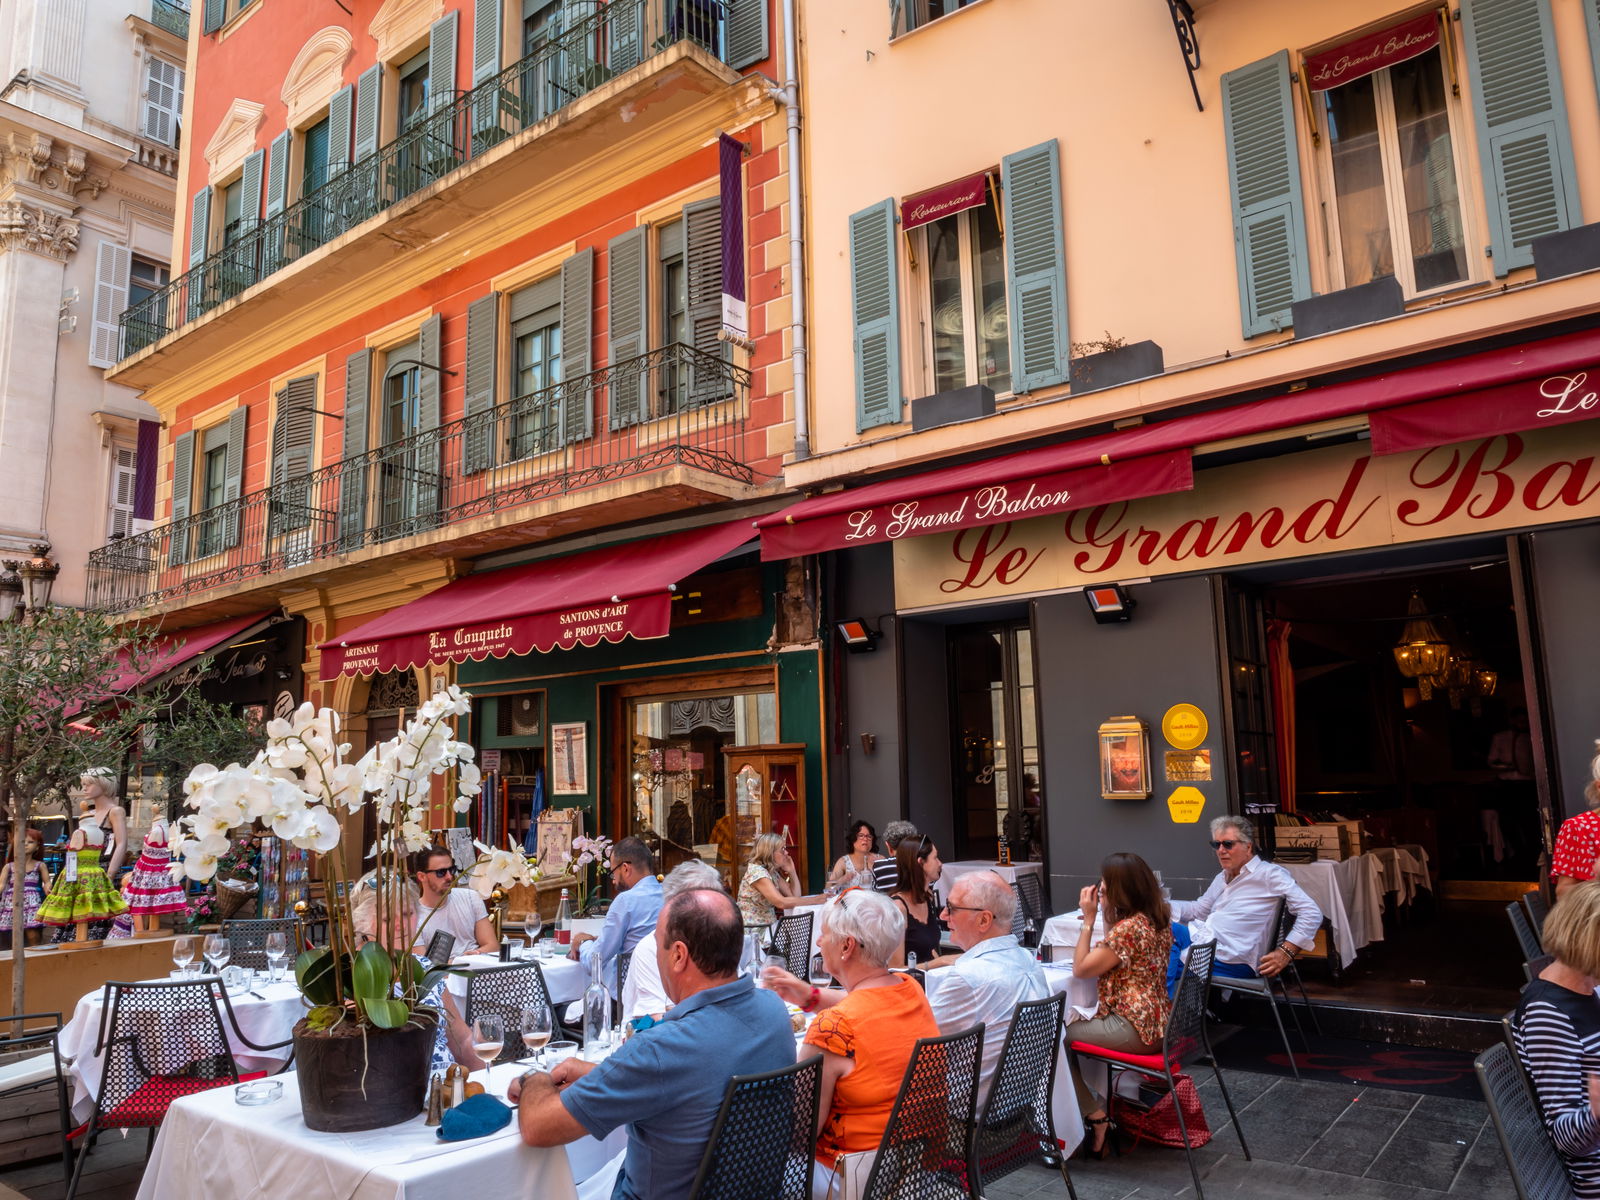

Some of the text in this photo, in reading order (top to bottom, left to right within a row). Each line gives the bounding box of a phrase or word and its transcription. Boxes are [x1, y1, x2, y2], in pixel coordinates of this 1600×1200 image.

[1312, 30, 1435, 81] Le Grand Balcon
[911, 191, 976, 221] Restaurant
[1536, 372, 1599, 418] Le
[845, 483, 1071, 541] Le Grand Balcon
[939, 521, 1047, 593] Le
[1064, 455, 1382, 574] Grand
[559, 604, 629, 625] SANTONS d'ART
[563, 620, 624, 639] de PROVENCE
[344, 644, 379, 658] ARTISANAT
[429, 623, 513, 654] La Couqueto
[342, 657, 379, 671] PROVENÇAL
